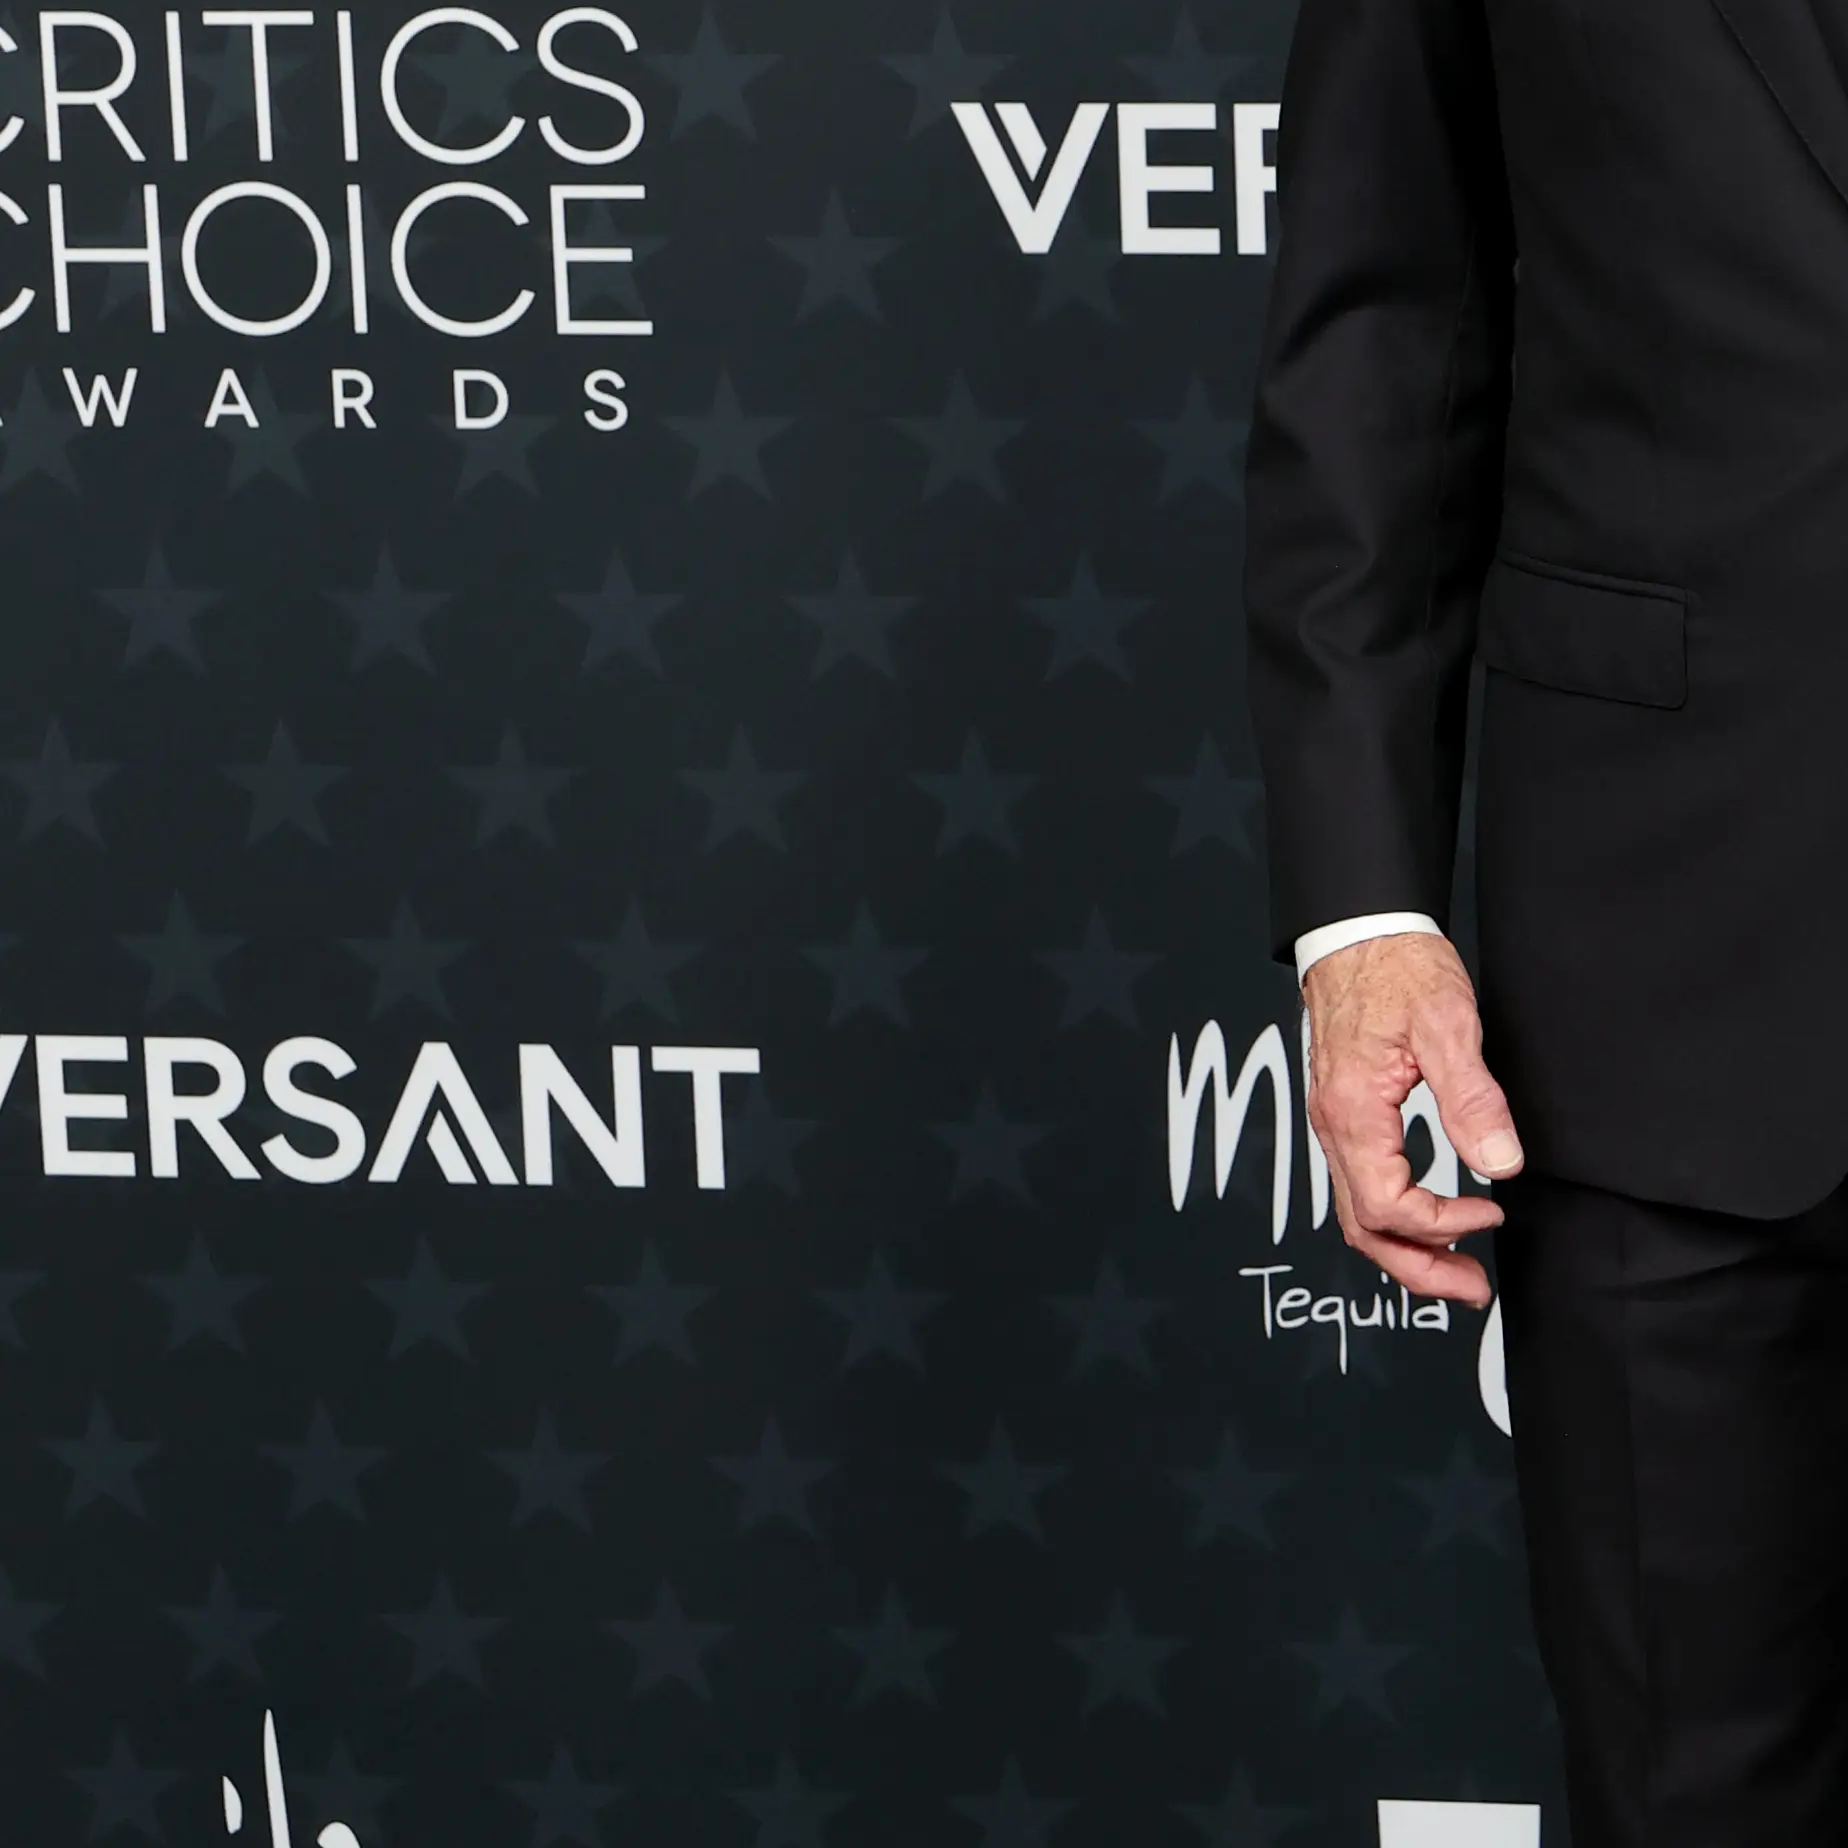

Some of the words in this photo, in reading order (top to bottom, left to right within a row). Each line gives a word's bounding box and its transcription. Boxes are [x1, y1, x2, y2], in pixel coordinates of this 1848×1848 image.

[0, 7, 645, 165] RITICS
[0, 181, 653, 337] HOICE
[0, 367, 628, 431] WARDS
[0, 1034, 761, 1190] ERSANT
[1239, 1264, 1449, 1375] Tequila
